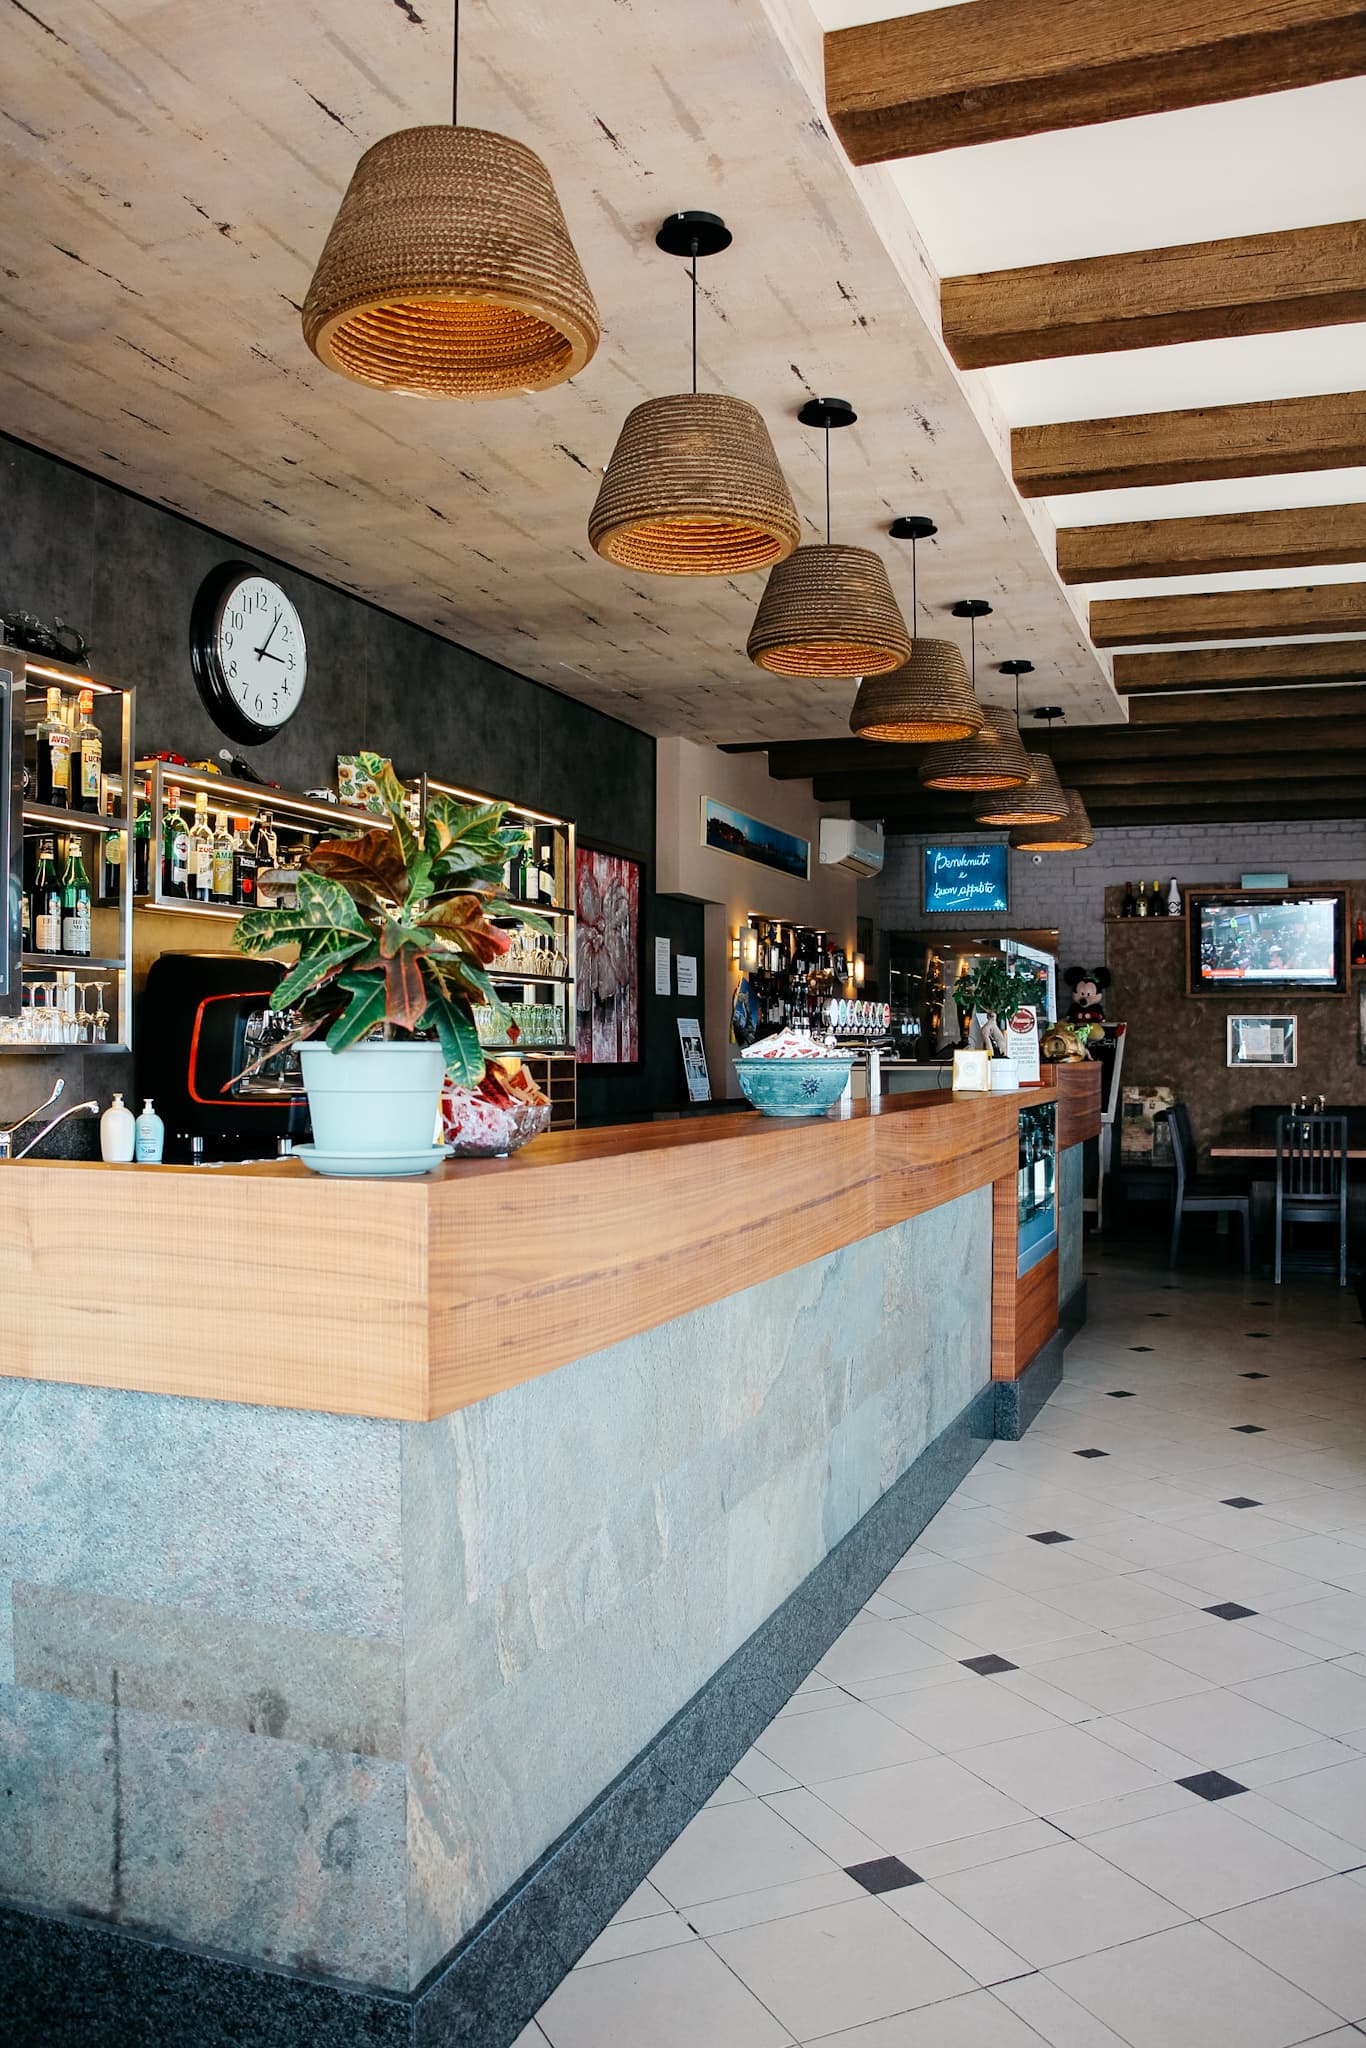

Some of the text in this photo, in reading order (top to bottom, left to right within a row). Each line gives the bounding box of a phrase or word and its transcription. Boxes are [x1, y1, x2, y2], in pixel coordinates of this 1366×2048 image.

[243, 595, 252, 614] 11
[256, 592, 268, 612] 12
[231, 611, 243, 631] 10
[225, 632, 234, 651] 9
[282, 625, 289, 642] 2
[229, 661, 238, 678] 8
[286, 654, 294, 671] 3
[242, 682, 249, 699] 7
[281, 677, 288, 694] 4
[255, 694, 263, 712] 6
[271, 692, 278, 709] 5
[934, 851, 991, 874] Benvenuti
[958, 871, 968, 879] e
[934, 881, 996, 898] buon appetito
